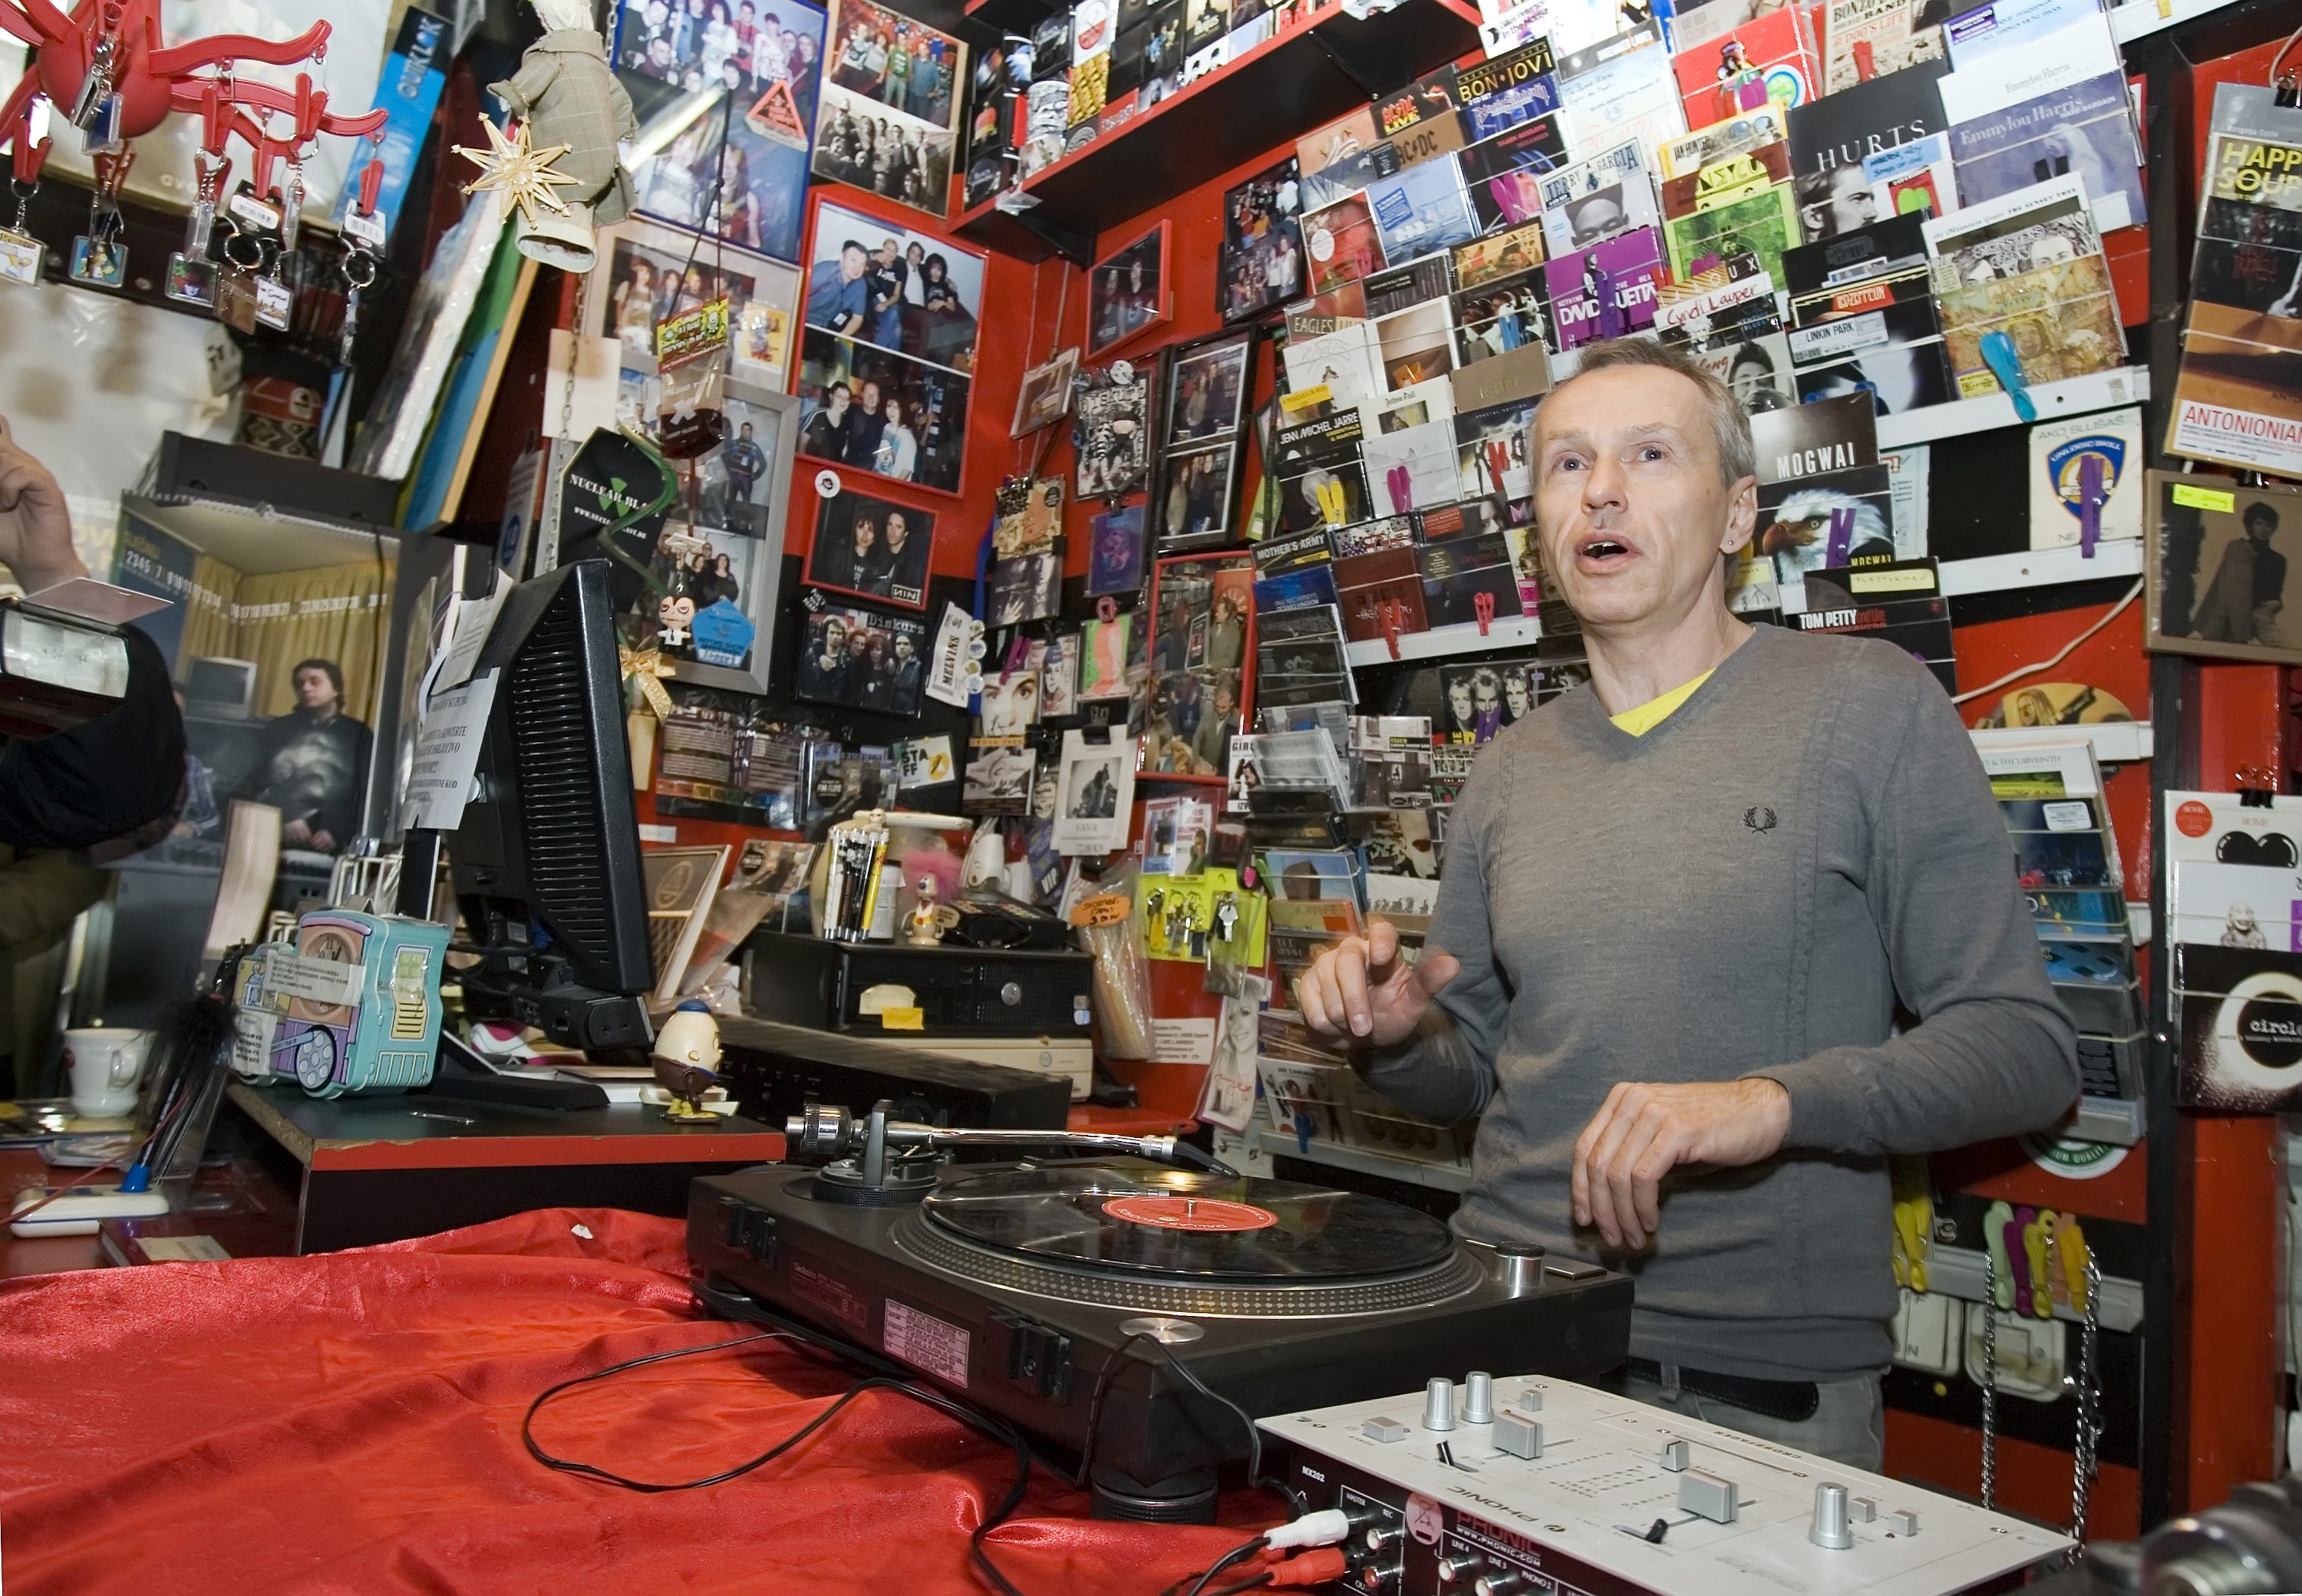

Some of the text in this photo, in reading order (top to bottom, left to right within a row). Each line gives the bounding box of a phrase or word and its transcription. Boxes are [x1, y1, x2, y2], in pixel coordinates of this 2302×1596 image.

[1384, 110, 1419, 134] LIVE
[1959, 96, 2083, 145] Emmylou Harris
[1816, 119, 1927, 172] HURTS
[1545, 145, 1640, 199] JERRY GARCIA
[1557, 295, 1585, 308] NOTHING
[1667, 283, 1757, 326] Cyndi Lauper
[1294, 316, 1334, 335] EAGLES
[1806, 321, 1855, 343] LINKIN PARK
[1280, 411, 1360, 444] JEAN MICHEL JARRE
[2037, 427, 2067, 440] AKO
[1776, 441, 1855, 480] MOGWAI
[569, 473, 622, 503] NUCLEAR
[1257, 534, 1326, 560] MOTHER'S ARMY
[1850, 553, 1891, 567] MOGWAI
[1799, 612, 1825, 630] TOM
[1825, 608, 1858, 628] PETTY
[942, 634, 960, 687] MELVINS
[901, 747, 929, 763] STA
[1999, 757, 2015, 766] THE
[2017, 755, 2063, 765] LABYRINTH
[902, 763, 918, 777] FF
[1301, 1466, 1326, 1483] MX202
[1345, 1492, 1367, 1508] MASTER
[1446, 1485, 1540, 1523] PHONIC
[1382, 1508, 1394, 1519] REC
[1451, 1539, 1466, 1551] LINE
[1456, 1524, 1542, 1568] WWW.PHONIC.COM
[1488, 1555, 1502, 1568] LINE
[1521, 1569, 1547, 1588] PHONO
